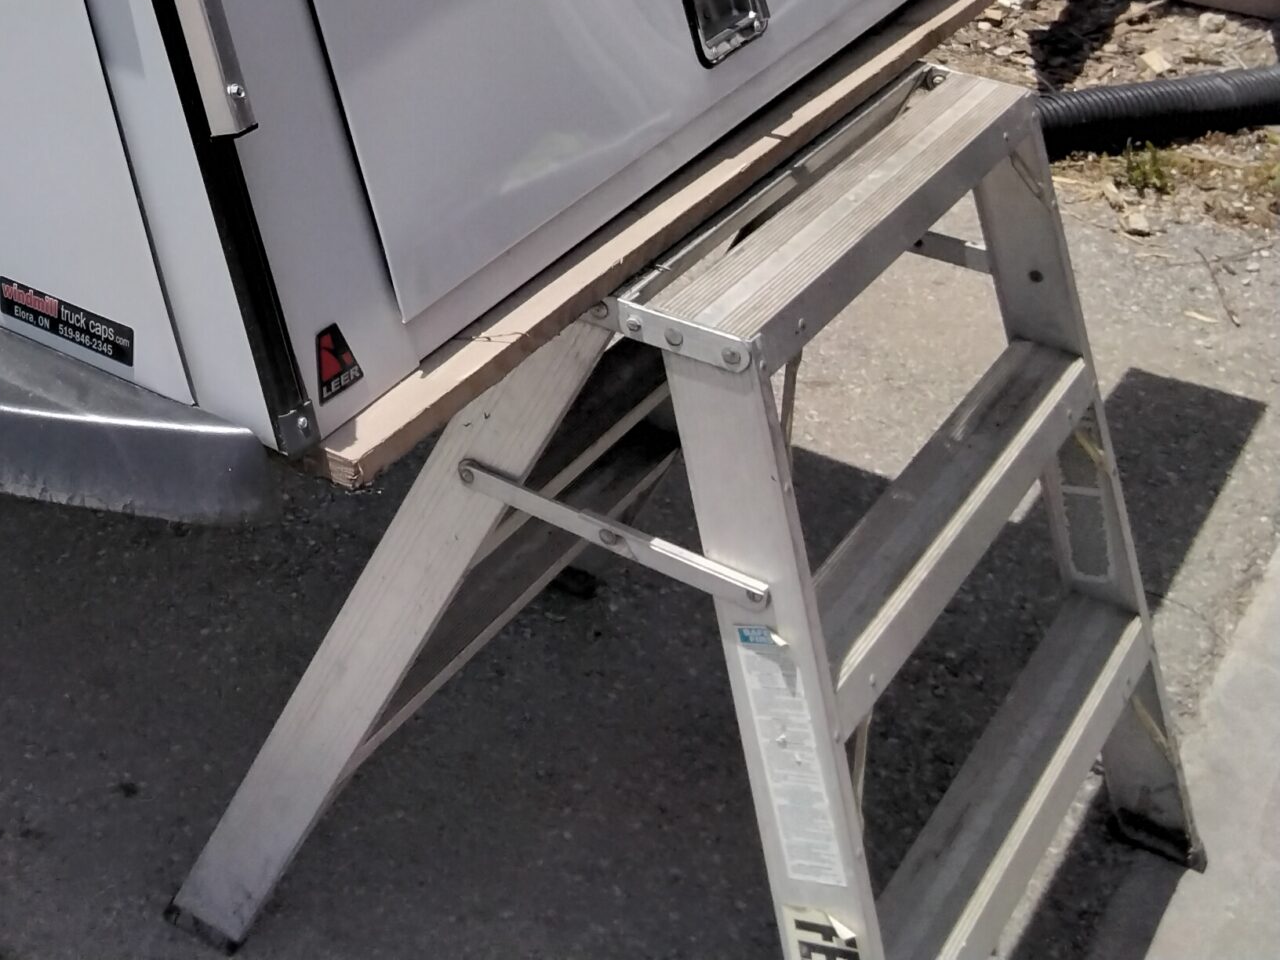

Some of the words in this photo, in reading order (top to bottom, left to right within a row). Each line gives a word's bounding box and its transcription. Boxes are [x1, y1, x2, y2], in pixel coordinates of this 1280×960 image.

[1, 282, 59, 319] windmill
[61, 305, 86, 330] truck
[14, 306, 36, 326] Elora,
[38, 316, 50, 330] ON
[58, 325, 113, 356] 519-846-2345
[322, 364, 361, 398] LEER
